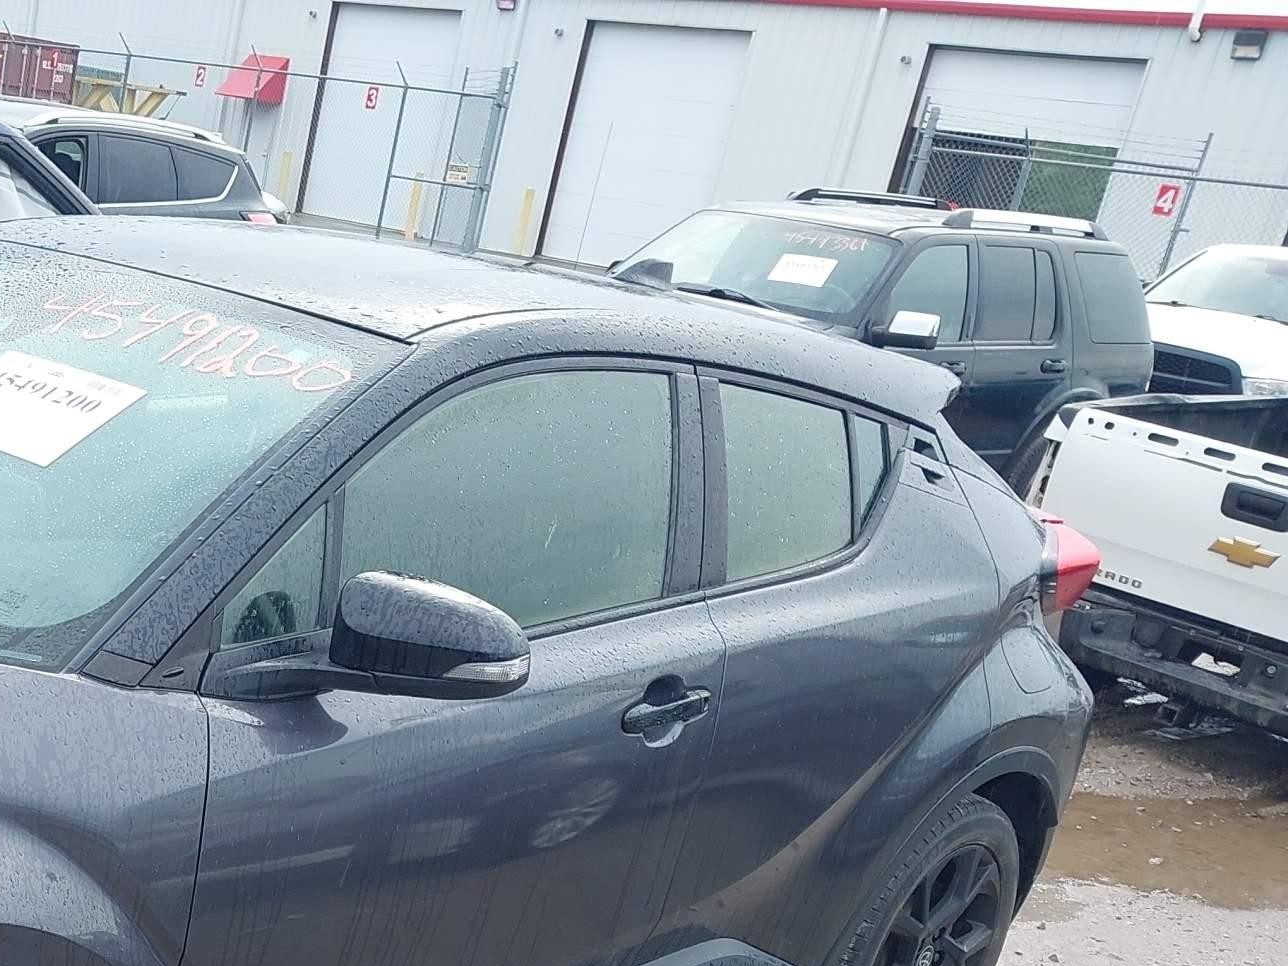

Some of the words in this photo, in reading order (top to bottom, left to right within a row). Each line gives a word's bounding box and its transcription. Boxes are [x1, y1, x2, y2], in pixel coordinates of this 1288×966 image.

[195, 68, 206, 86] 2
[366, 88, 378, 108] 3
[1156, 188, 1177, 213] 4
